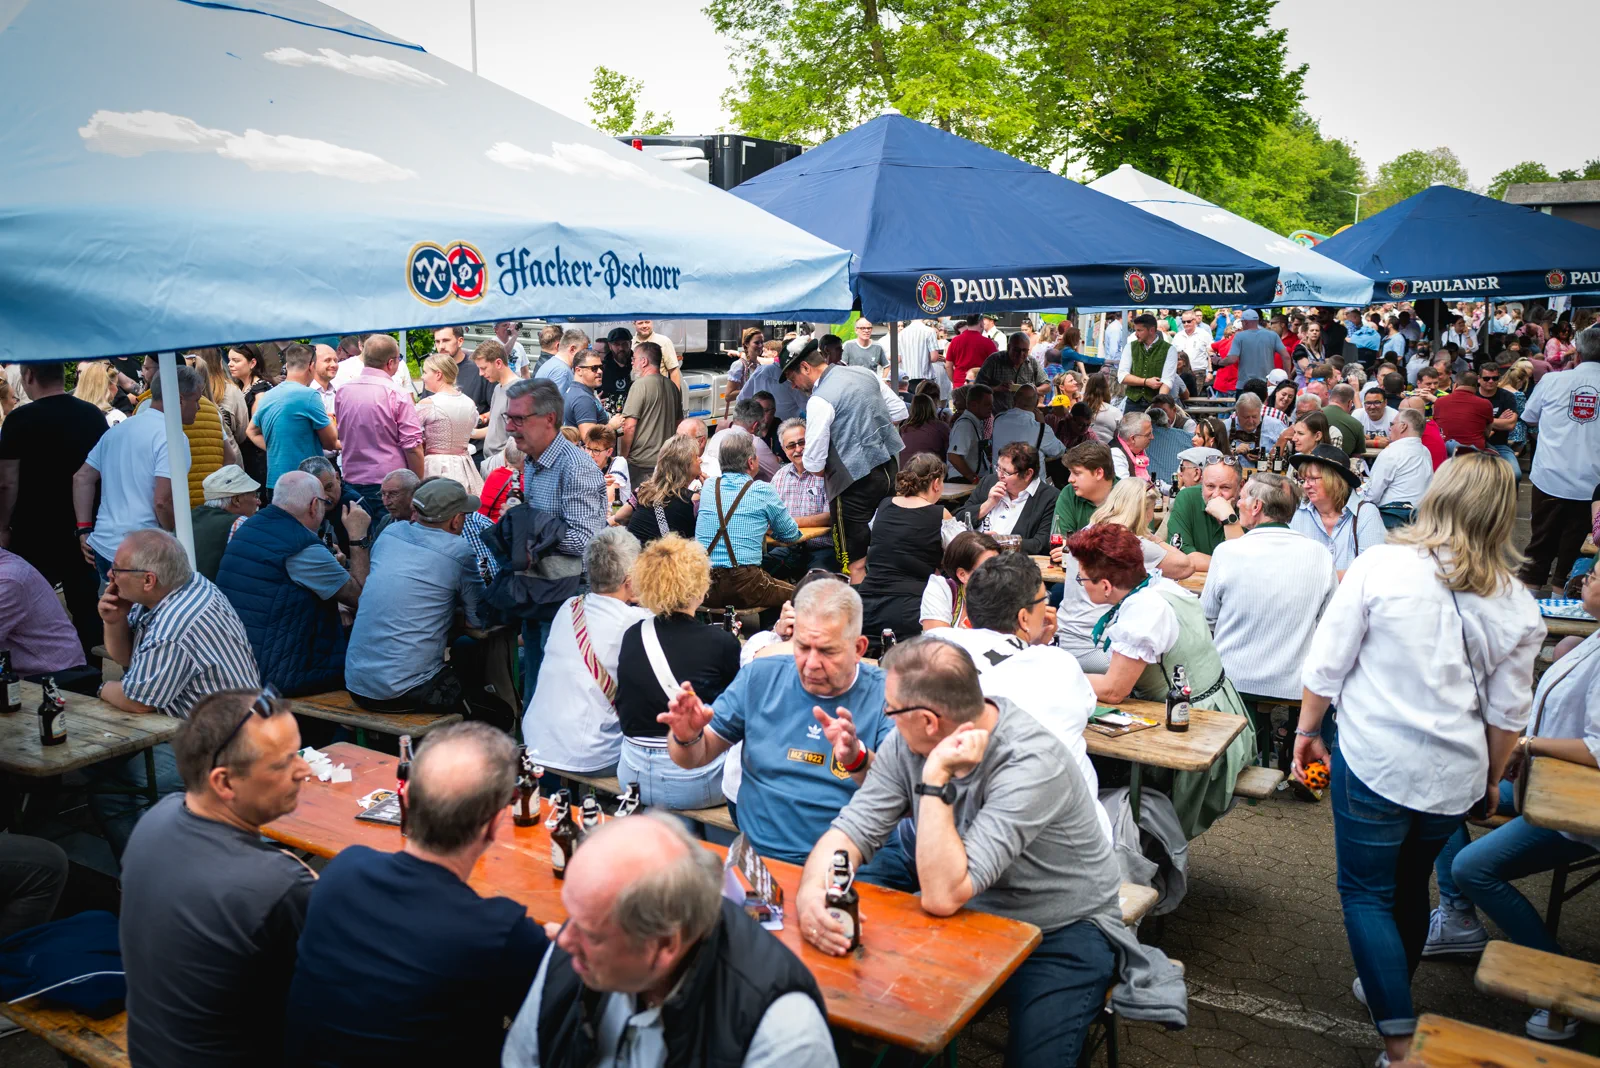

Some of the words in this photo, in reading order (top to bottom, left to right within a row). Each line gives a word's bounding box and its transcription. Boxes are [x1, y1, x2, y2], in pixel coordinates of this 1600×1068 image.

[496, 245, 681, 300] Hacker-Pschorr
[918, 275, 944, 291] PAULANER
[1151, 272, 1247, 295] PAULANER
[951, 274, 1073, 303] PAULANER
[1411, 276, 1500, 294] PAULANER
